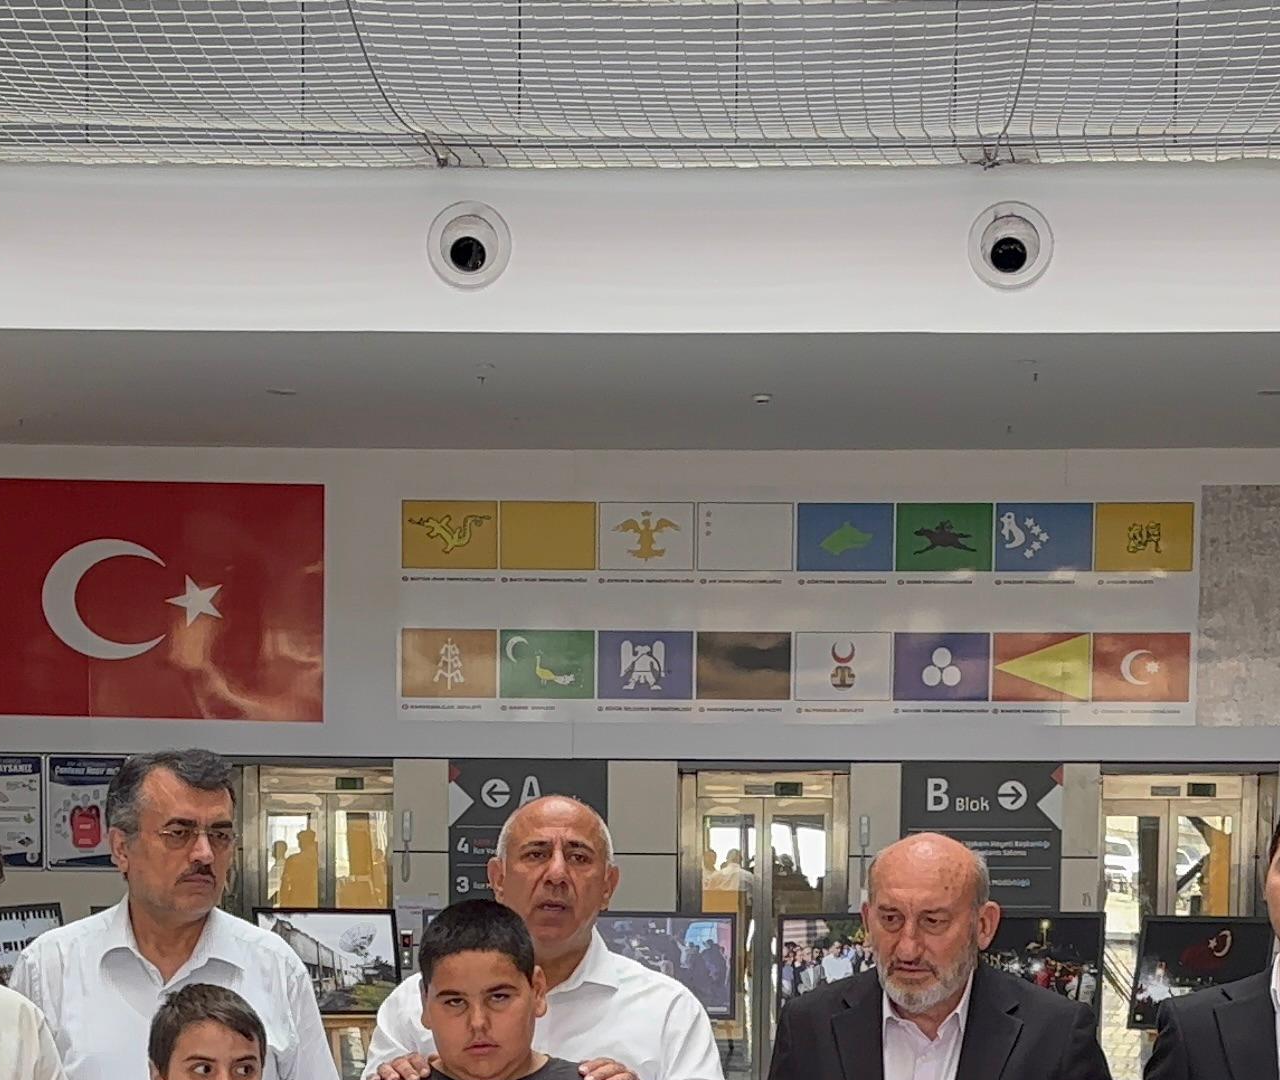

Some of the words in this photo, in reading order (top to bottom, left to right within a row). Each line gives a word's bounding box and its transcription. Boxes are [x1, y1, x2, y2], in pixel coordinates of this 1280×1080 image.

[519, 775, 542, 804] A
[927, 778, 949, 812] B
[955, 797, 990, 812] Blok
[457, 837, 469, 854] 4
[456, 876, 470, 893] 3
